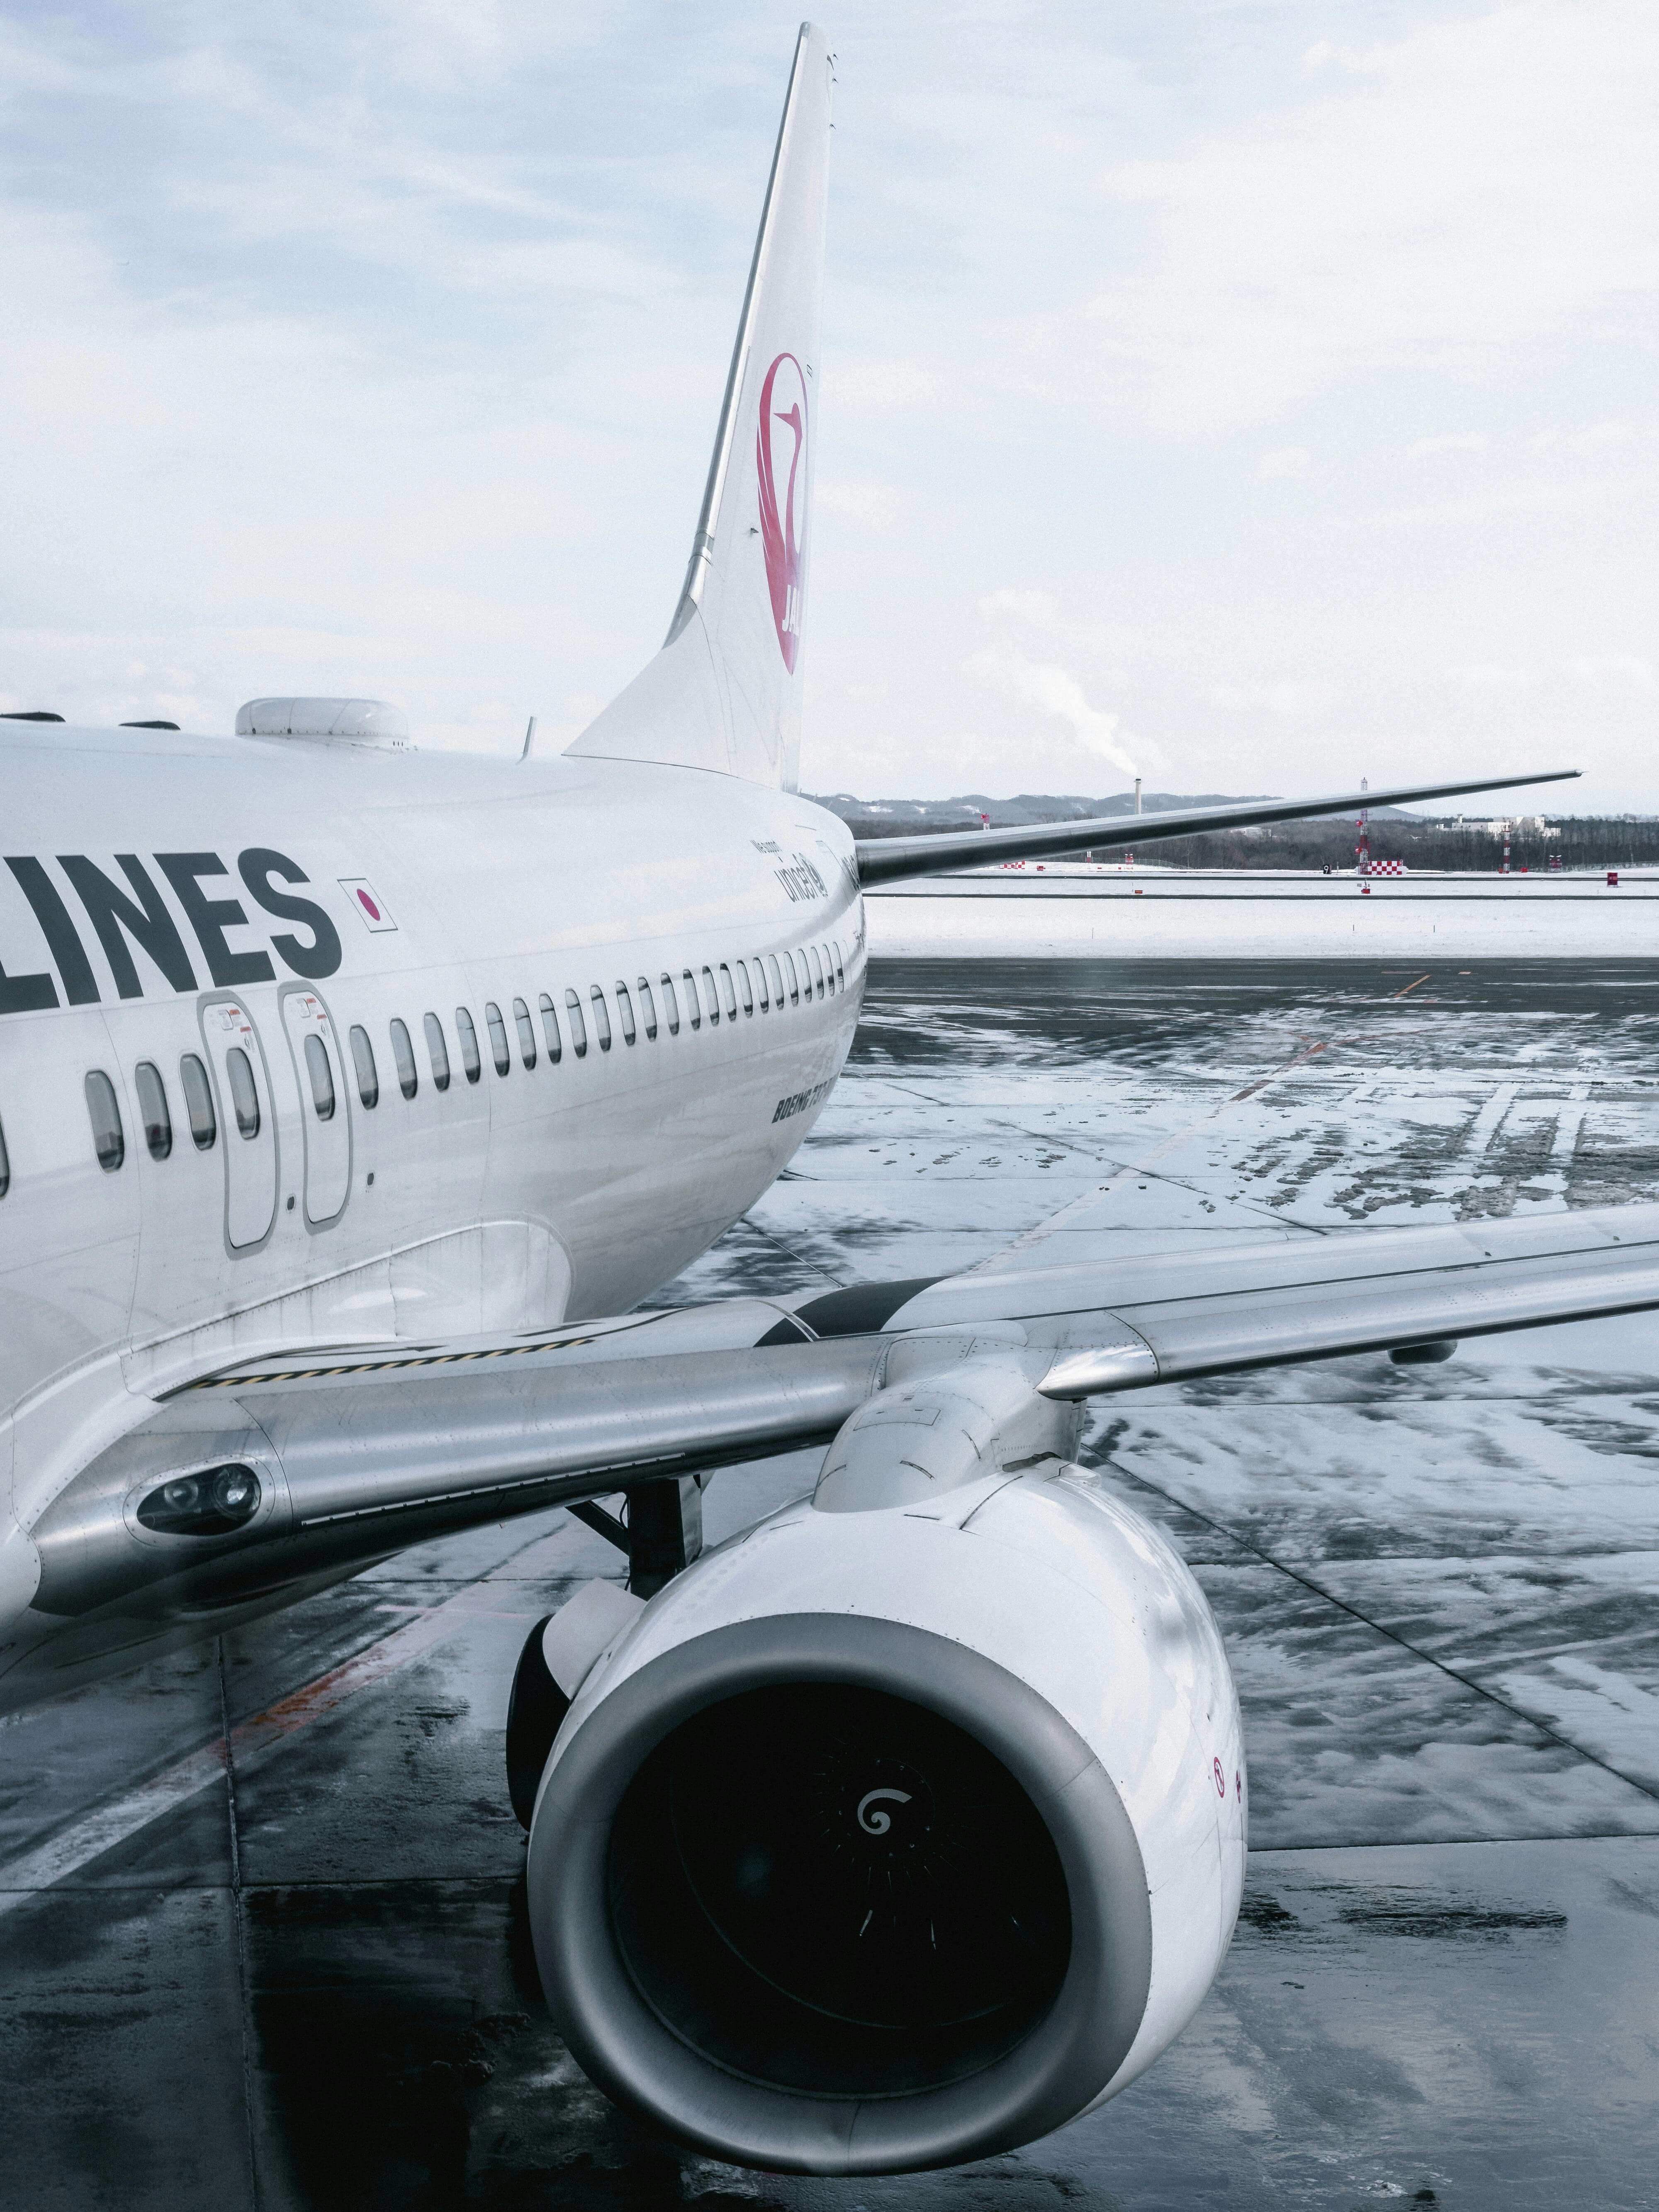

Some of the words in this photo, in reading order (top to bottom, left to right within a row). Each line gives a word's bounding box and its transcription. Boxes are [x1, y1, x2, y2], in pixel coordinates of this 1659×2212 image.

[774, 853, 818, 903] unicef
[1324, 865, 1329, 874] 9
[771, 1088, 812, 1124] BOEING
